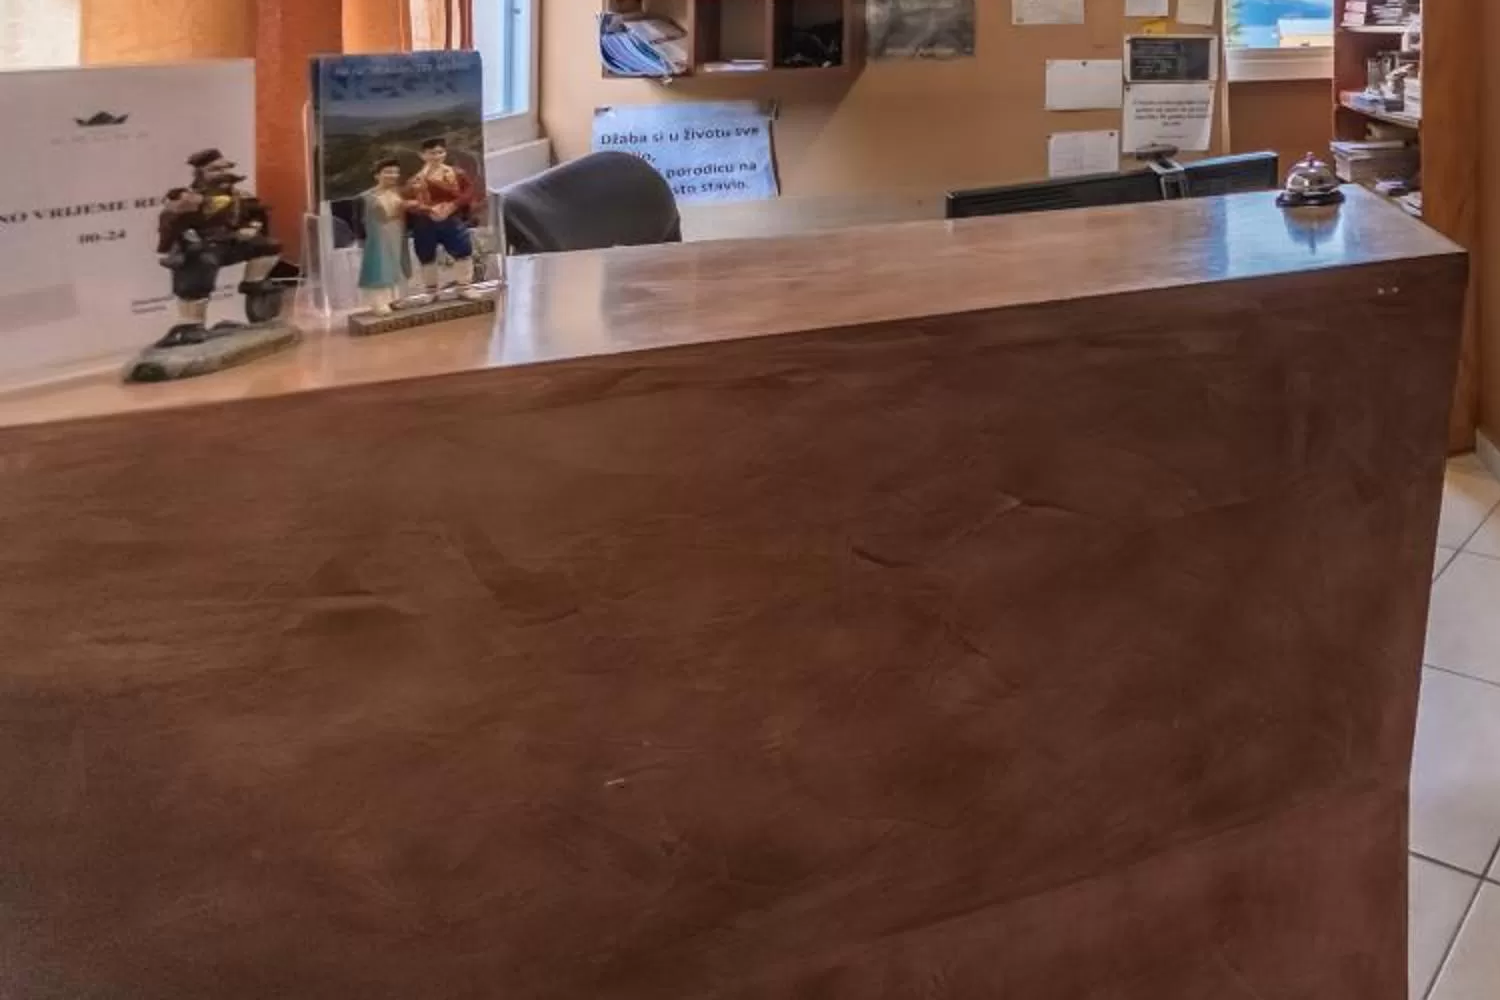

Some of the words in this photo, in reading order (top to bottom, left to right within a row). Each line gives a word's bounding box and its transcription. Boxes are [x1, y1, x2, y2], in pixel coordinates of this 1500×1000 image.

[600, 130, 647, 146] Džaba
[651, 131, 664, 144] si
[669, 133, 680, 143] u
[683, 126, 731, 142] životu
[734, 126, 760, 138] sve
[665, 162, 735, 179] porodicu
[739, 161, 757, 172] na
[672, 183, 697, 195] sto
[32, 199, 128, 220] VRIJEME
